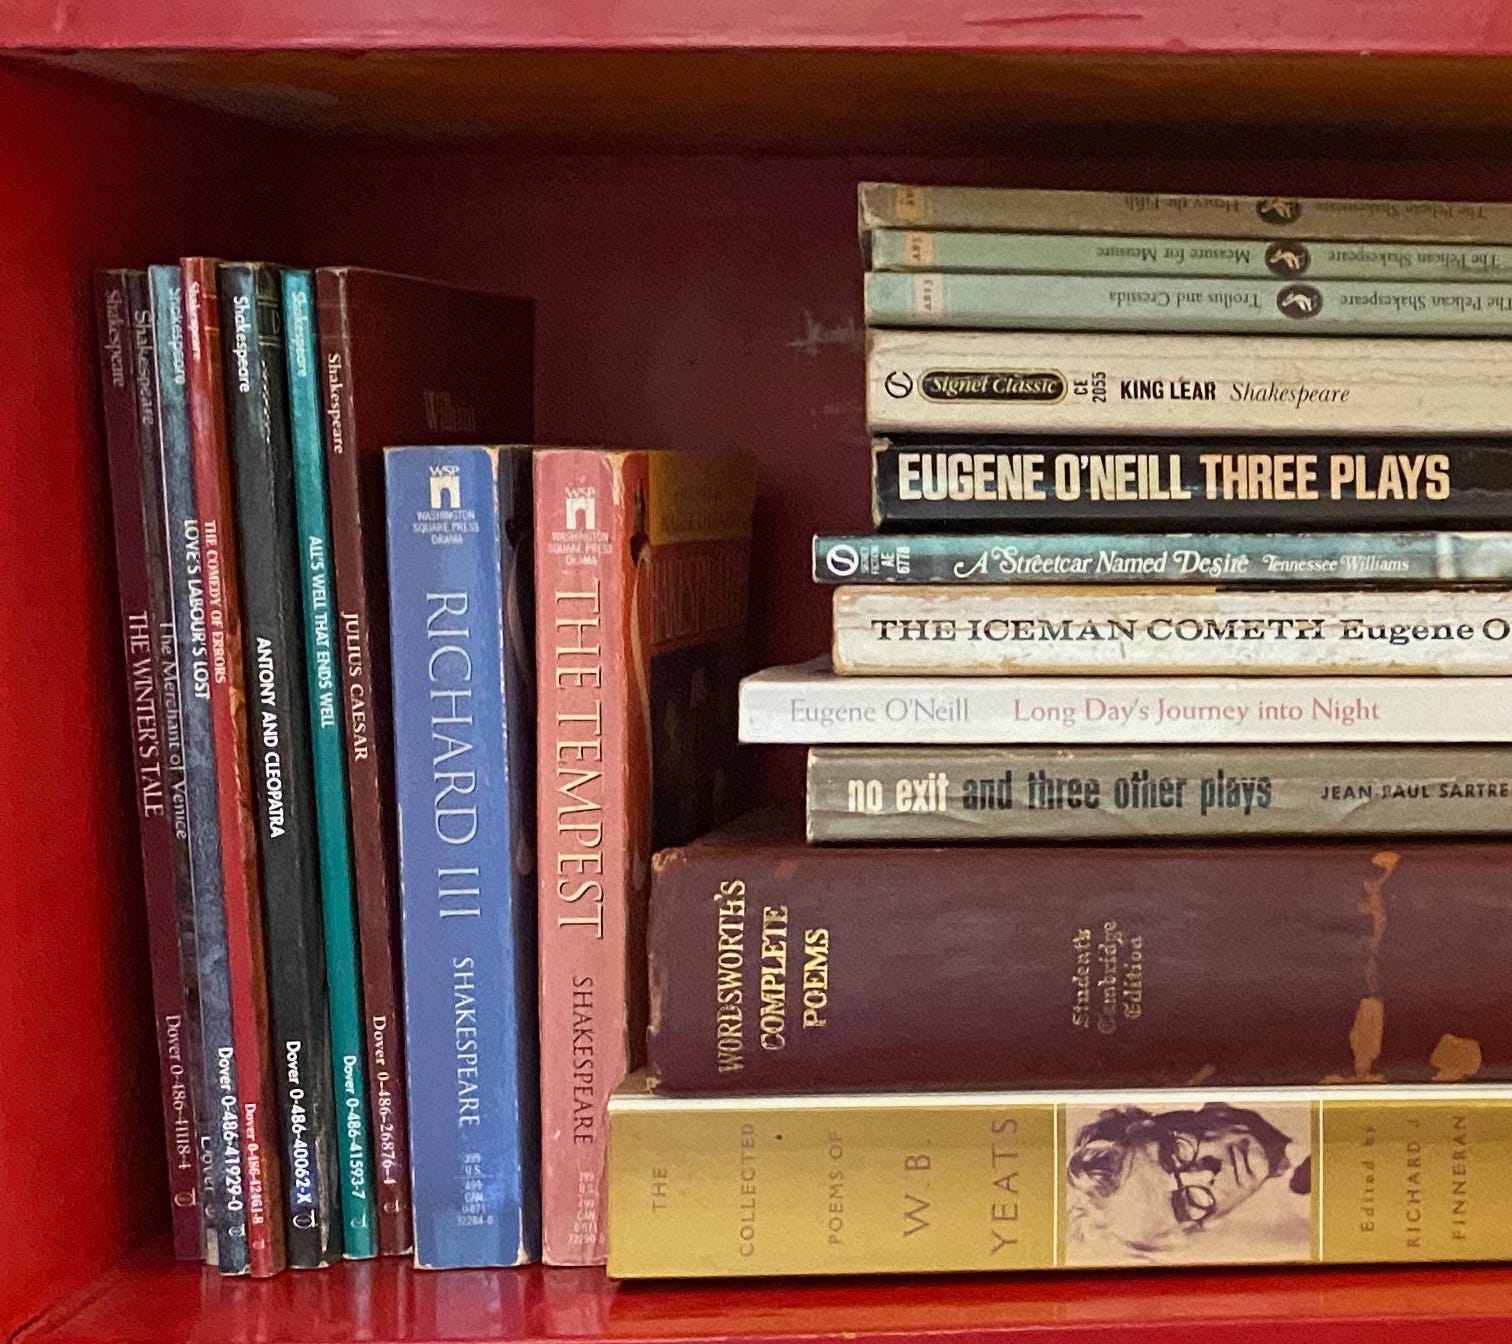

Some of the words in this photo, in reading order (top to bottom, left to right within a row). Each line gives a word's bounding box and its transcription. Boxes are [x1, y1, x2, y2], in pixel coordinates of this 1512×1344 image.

[899, 453, 1046, 500] EUGENE
[1055, 453, 1190, 500] O'NEILL
[1200, 455, 1317, 500] THREE
[1331, 455, 1450, 500] PLAYS
[257, 637, 275, 706] ANTONY
[555, 578, 601, 690] THE
[871, 619, 956, 641] THE
[966, 619, 1136, 642] ICEMAN
[1146, 618, 1325, 641] COMETH
[1338, 619, 1474, 644] Eugene
[262, 712, 277, 747] AND
[426, 591, 479, 845] RICHARD
[791, 698, 876, 726] Eugene
[885, 698, 970, 722] O'Neill
[1013, 698, 1075, 725] Long
[1085, 698, 1149, 725] Day's
[1157, 698, 1247, 725] Journey
[1258, 701, 1303, 721] into
[1312, 698, 1380, 724] Night
[264, 751, 285, 839] CLEOPATRA
[557, 692, 604, 939] TEMPEST
[848, 776, 882, 812] no
[896, 772, 949, 812] exit
[962, 770, 1012, 810] and
[1028, 770, 1100, 810] three
[1114, 770, 1184, 809] other
[1200, 770, 1271, 816] plays
[438, 866, 481, 919] III
[714, 879, 745, 1073] WORDSWORTH'S
[760, 905, 787, 1051] COMPLETE
[803, 927, 829, 1029] POEMS
[286, 1041, 301, 1088] Dover
[453, 957, 480, 1128] SHAKESPEARE
[572, 976, 594, 1145] SHAKESPEARE
